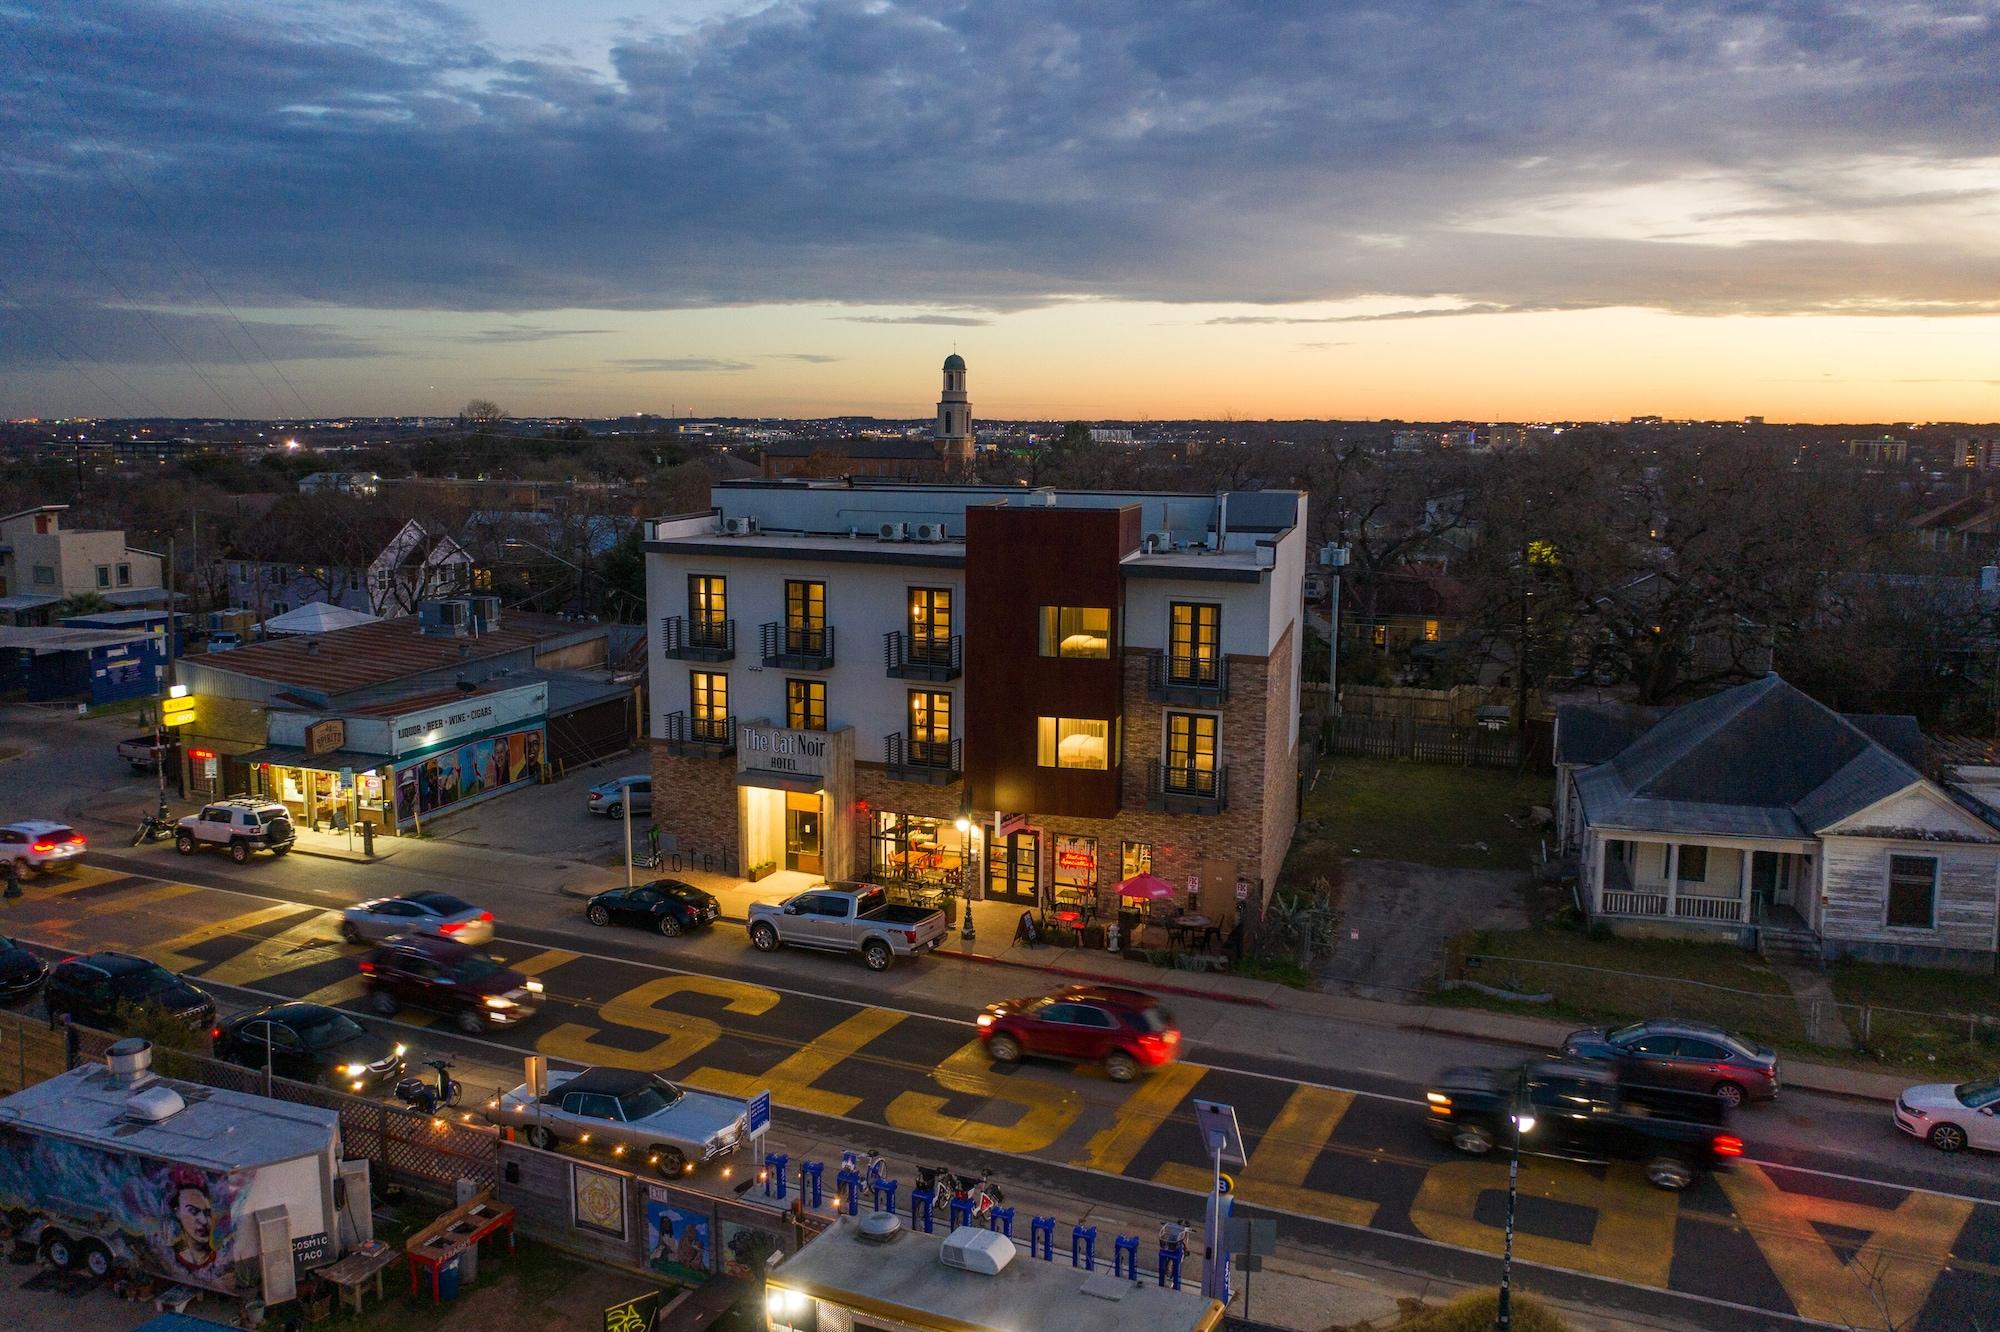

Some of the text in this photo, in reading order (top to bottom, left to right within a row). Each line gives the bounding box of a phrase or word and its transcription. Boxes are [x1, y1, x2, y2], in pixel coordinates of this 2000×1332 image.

[398, 706, 493, 739] LIQUOR BEER WINE CIGARS
[316, 732, 342, 748] SPIRITS
[743, 728, 826, 757] The Cat Noir
[771, 757, 798, 771] HOTEL
[648, 1185, 668, 1203] EXIT
[292, 1235, 328, 1251] COSMIC
[297, 1249, 322, 1262] TACO
